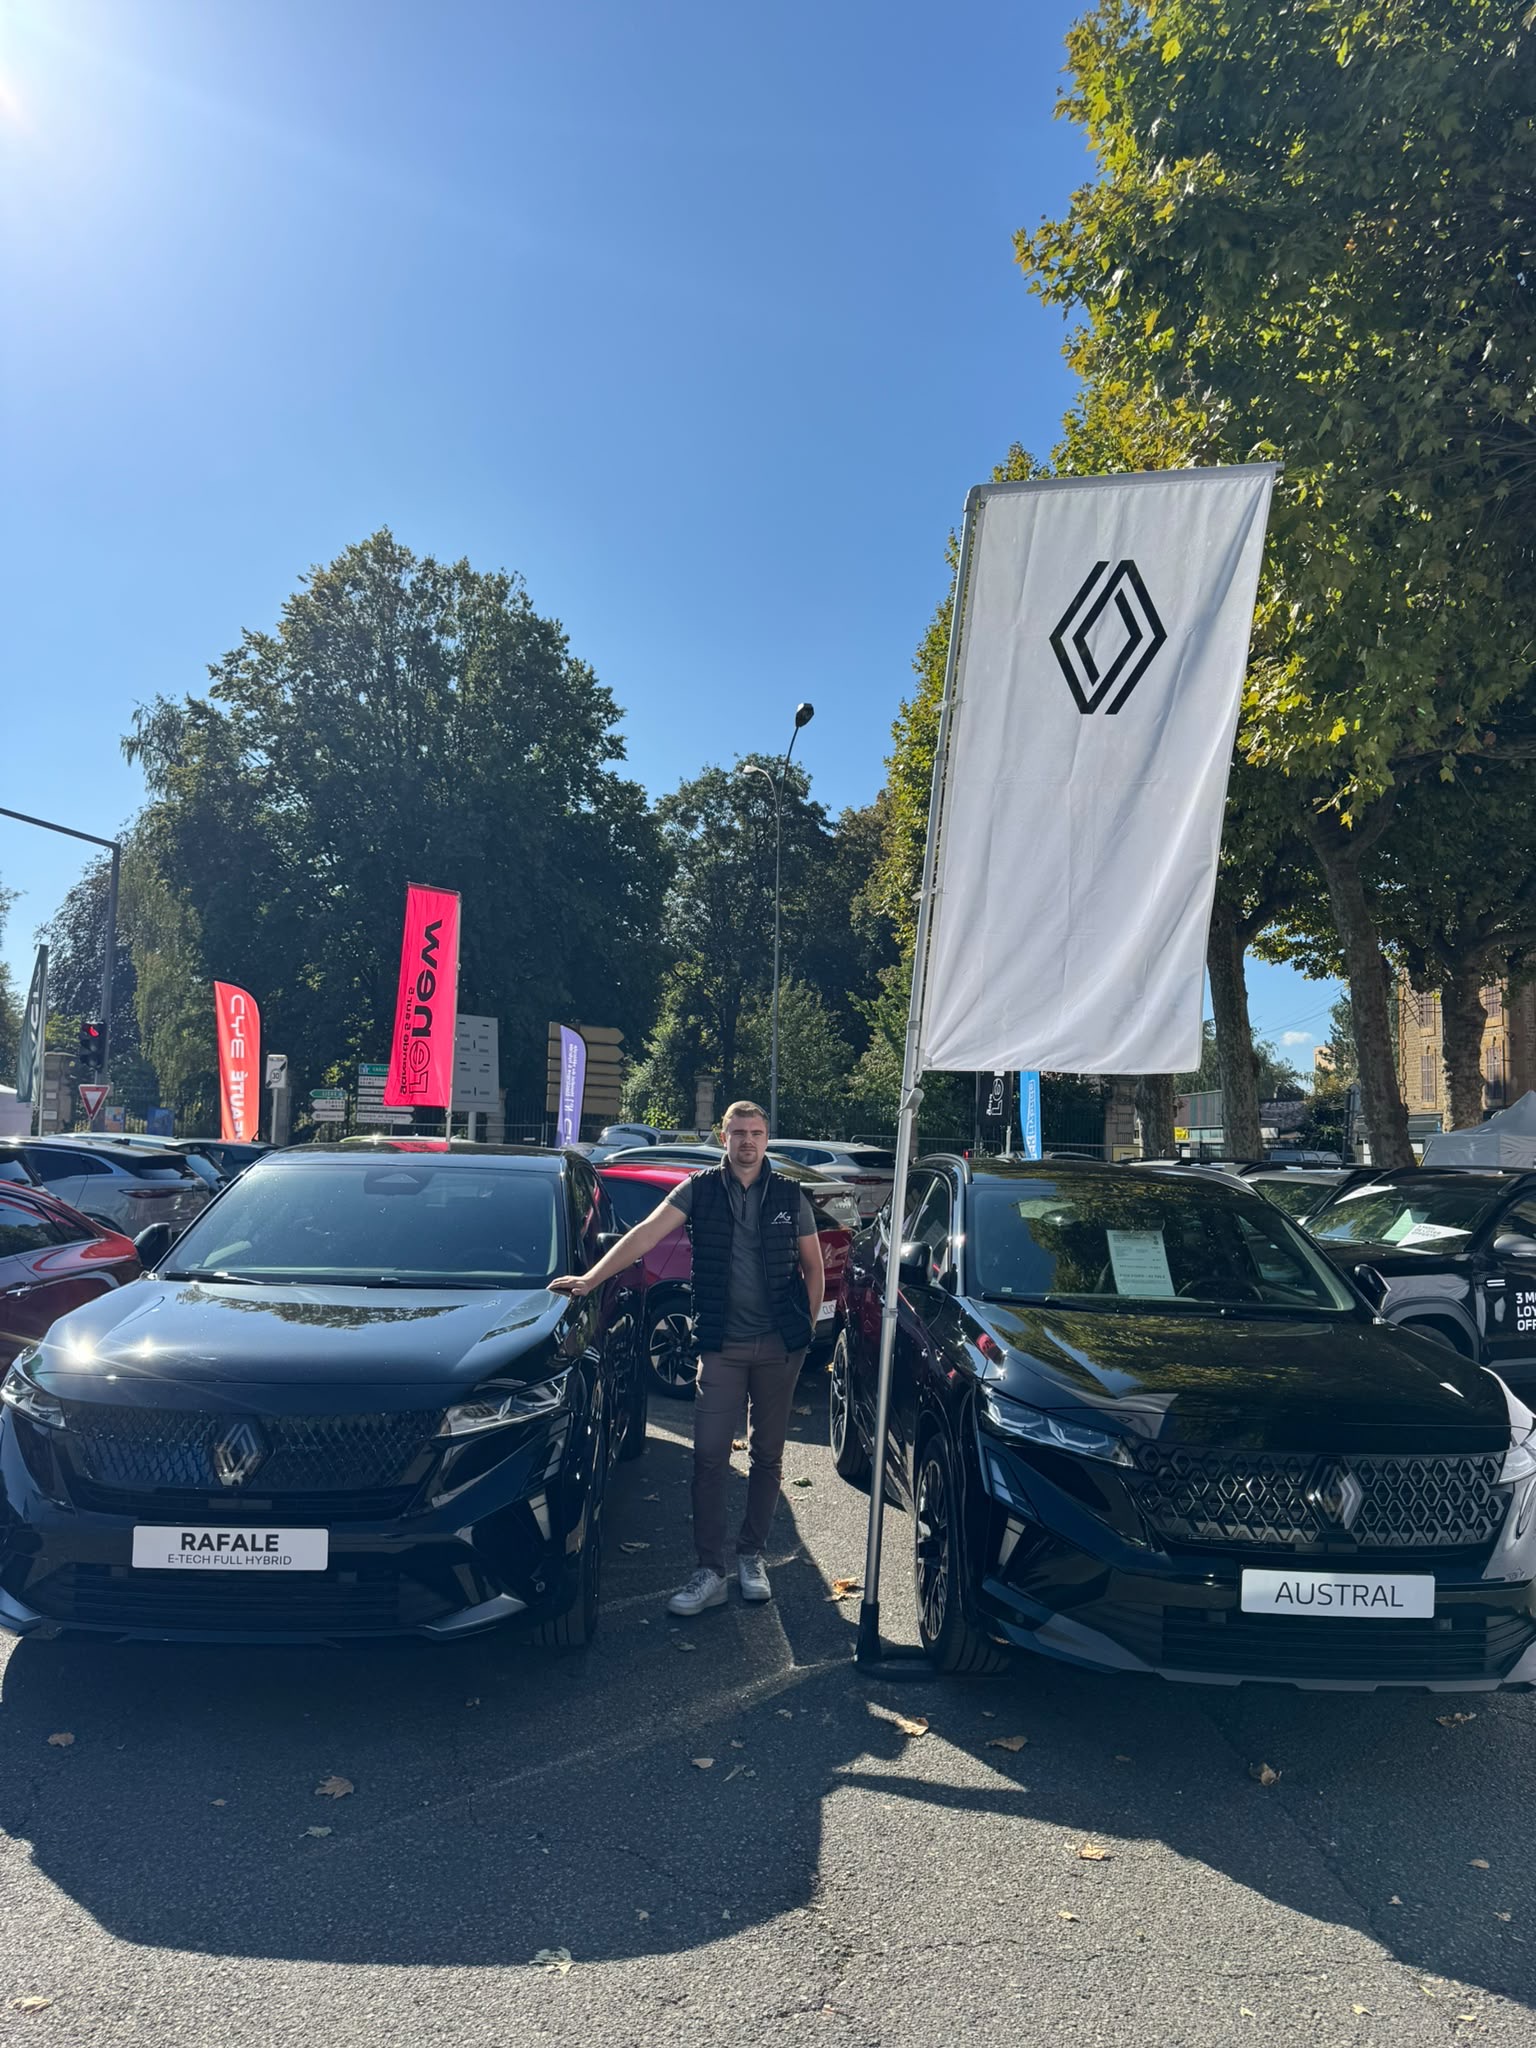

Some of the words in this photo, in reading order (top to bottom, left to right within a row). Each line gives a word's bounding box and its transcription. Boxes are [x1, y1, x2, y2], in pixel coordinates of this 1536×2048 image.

[1515, 1292, 1523, 1304] 3
[181, 1532, 280, 1552] RAFALE
[167, 1554, 211, 1564] E-TECH
[213, 1555, 243, 1565] FULL
[245, 1555, 292, 1566] HYBRID
[1274, 1581, 1404, 1608] AUSTRAL
